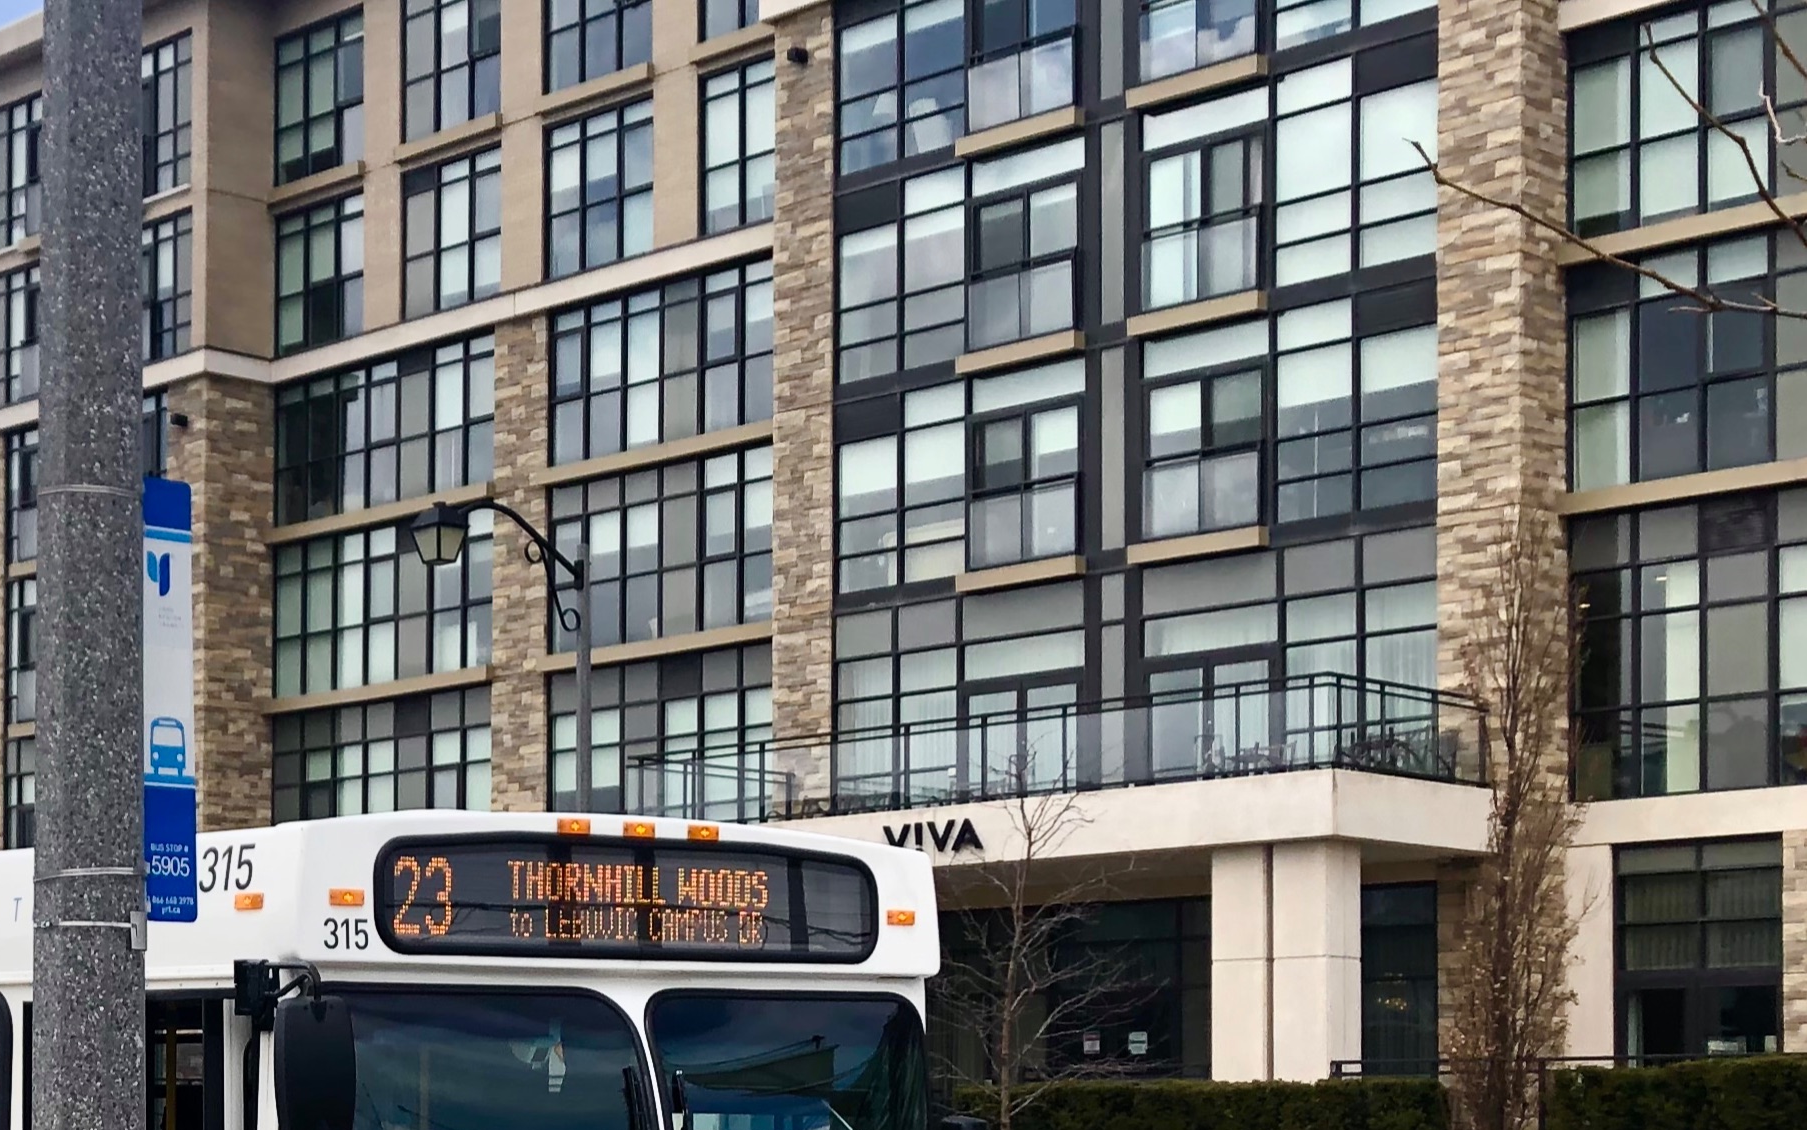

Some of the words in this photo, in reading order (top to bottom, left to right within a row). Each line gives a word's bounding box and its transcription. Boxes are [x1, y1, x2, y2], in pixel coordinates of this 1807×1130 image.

[150, 843, 165, 852] BUS
[166, 843, 183, 853] STOP
[151, 855, 191, 877] 5905
[199, 843, 256, 893] 315
[394, 856, 452, 935] 23
[508, 860, 666, 904] THORNHILL
[678, 867, 769, 908] WOODS
[323, 918, 369, 950] 315
[510, 908, 533, 938] to
